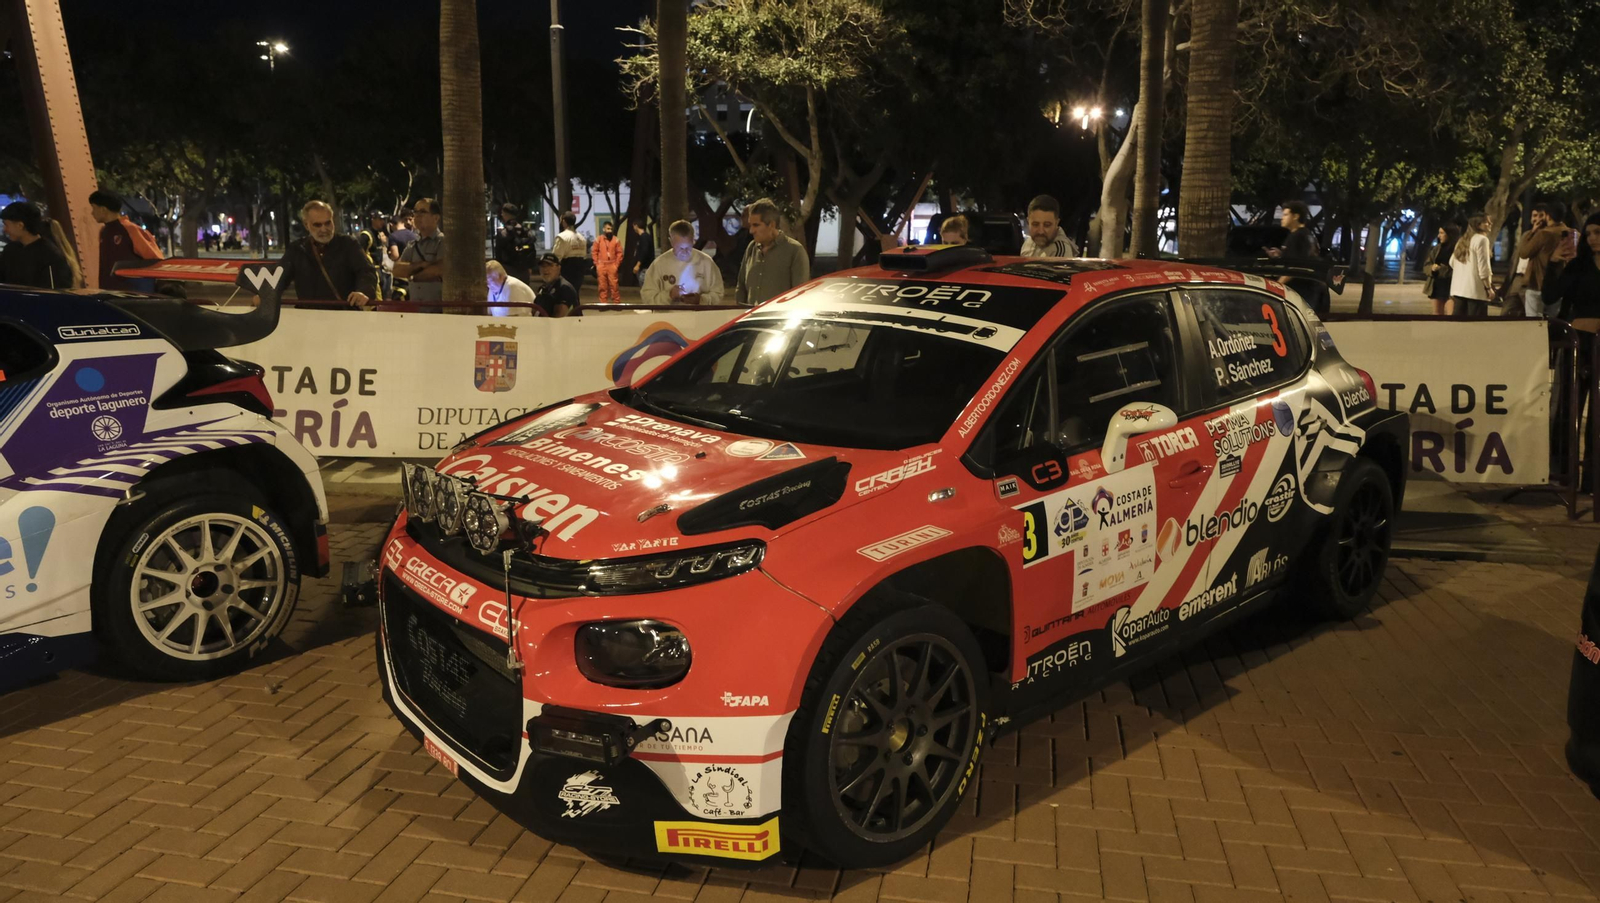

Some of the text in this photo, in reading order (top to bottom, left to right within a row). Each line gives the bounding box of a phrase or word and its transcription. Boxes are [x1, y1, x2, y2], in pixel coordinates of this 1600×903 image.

[823, 282, 992, 303] CITROËN
[1261, 303, 1287, 357] 3
[331, 366, 377, 396] DE
[1229, 357, 1274, 383] Sánchez
[46, 397, 79, 408] Organismo
[80, 394, 110, 404] Autónomo
[119, 389, 143, 398] Deportes
[49, 396, 147, 419] deporte lagunero
[957, 358, 1022, 439] ALBERTOORDONEZ.COM
[1342, 389, 1370, 409] blendio
[1451, 384, 1508, 415] DE
[629, 416, 722, 444] Prenava
[1204, 410, 1250, 437] PEYMA
[106, 442, 128, 451] LAGUNA
[418, 432, 447, 451] DE
[1152, 426, 1199, 459] TORCA
[1213, 420, 1276, 458] SOLUTIONS
[525, 438, 645, 481] Bimenes
[1031, 460, 1062, 484] C3
[558, 463, 623, 490] SANEAMIENTOS
[855, 457, 937, 492] CRASH
[1000, 482, 1017, 493] MAIK
[739, 480, 812, 511] COSTAS Racing
[858, 483, 889, 497] CENTER
[1116, 485, 1153, 507] COSTA DE
[1109, 498, 1154, 527] ALMERÍA
[1185, 498, 1259, 547] blendio
[870, 529, 941, 556] TURINI
[1023, 511, 1038, 560] 3
[1061, 535, 1071, 549] 30
[269, 522, 297, 580] MICHELIN
[405, 556, 457, 594] ORECA
[1178, 571, 1238, 622] emerent
[1128, 624, 1169, 646] www.koparauto.com
[730, 695, 769, 707] FAPA
[821, 694, 841, 735] PIRELLI
[692, 772, 703, 784] La
[666, 828, 770, 853] PIRELLI
